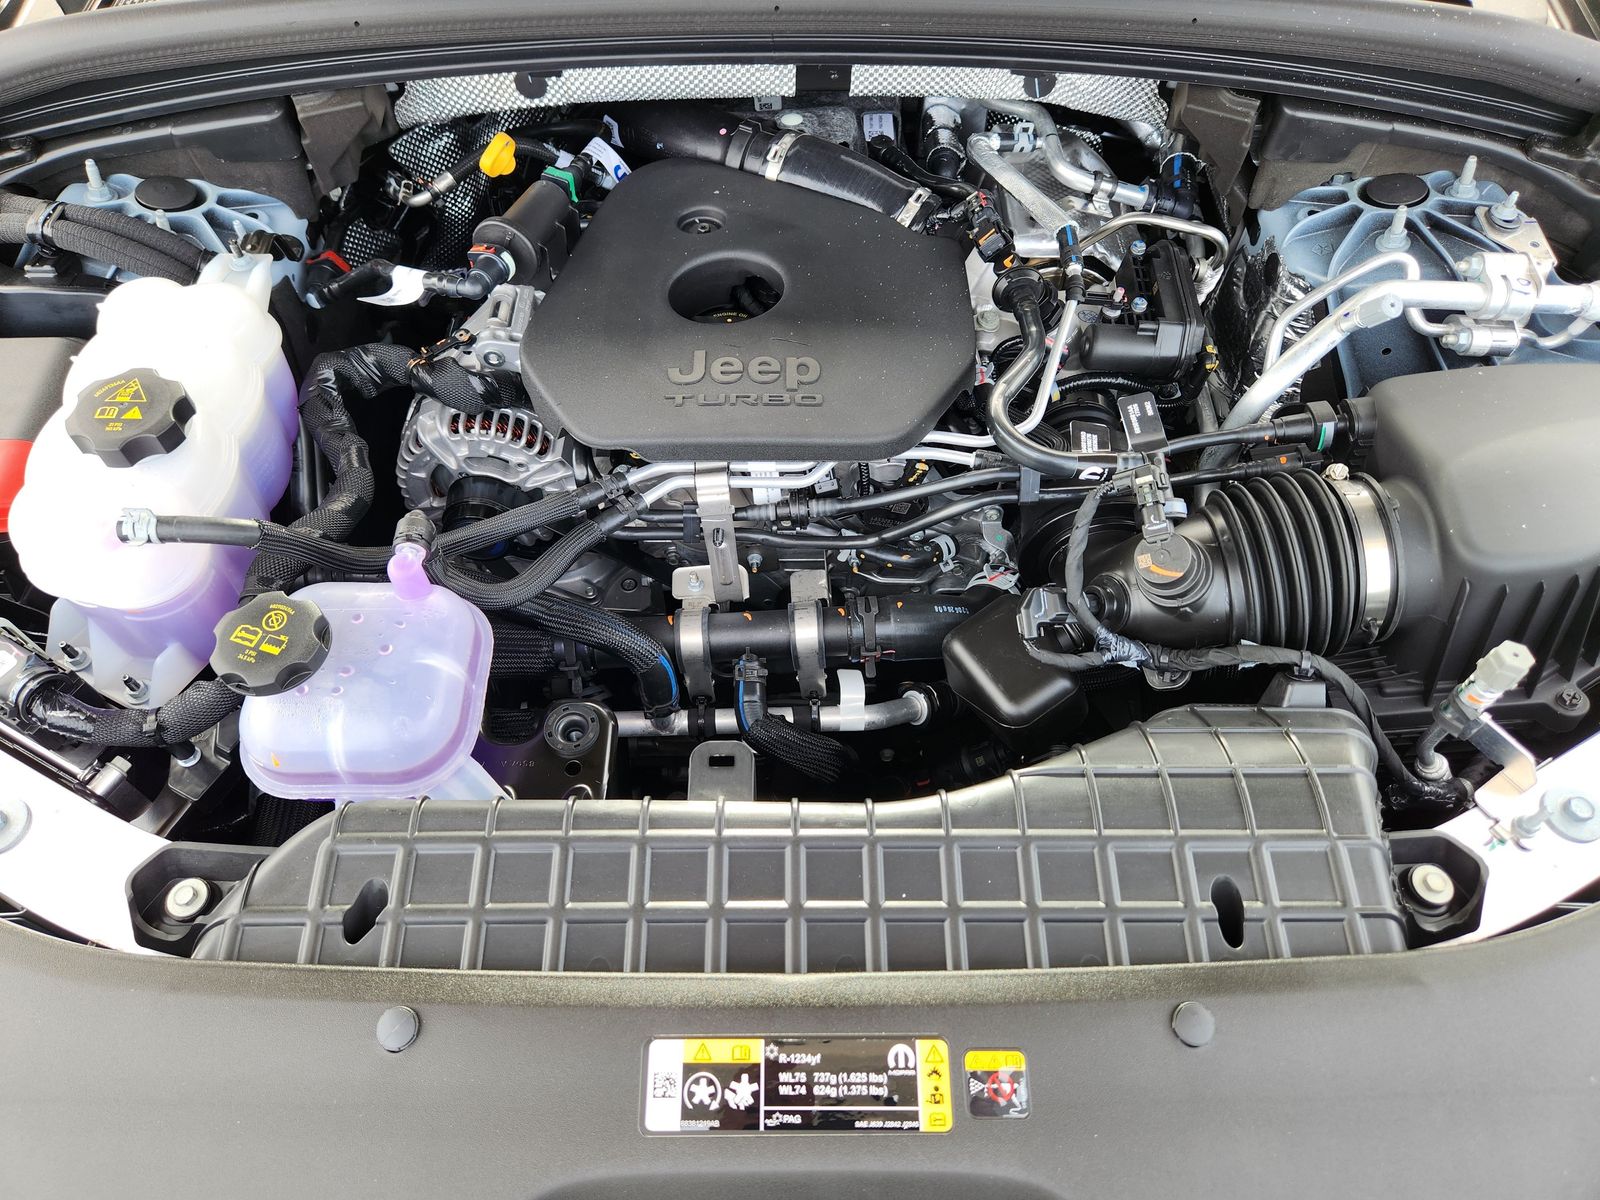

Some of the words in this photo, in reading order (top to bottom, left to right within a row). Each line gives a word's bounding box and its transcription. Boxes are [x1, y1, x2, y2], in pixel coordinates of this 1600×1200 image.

[667, 349, 822, 392] Jeep
[664, 393, 824, 407] TURBO
[778, 1052, 822, 1066] R-1234yf
[778, 1071, 807, 1083] WL75
[813, 1071, 837, 1085] 737g
[838, 1071, 868, 1085] (1.625
[868, 1071, 888, 1085] lbs)
[778, 1084, 807, 1095] WL74
[812, 1085, 837, 1098] 624g
[838, 1085, 868, 1098] (1.375
[868, 1085, 889, 1098] lbs)
[782, 1114, 802, 1124] PAG
